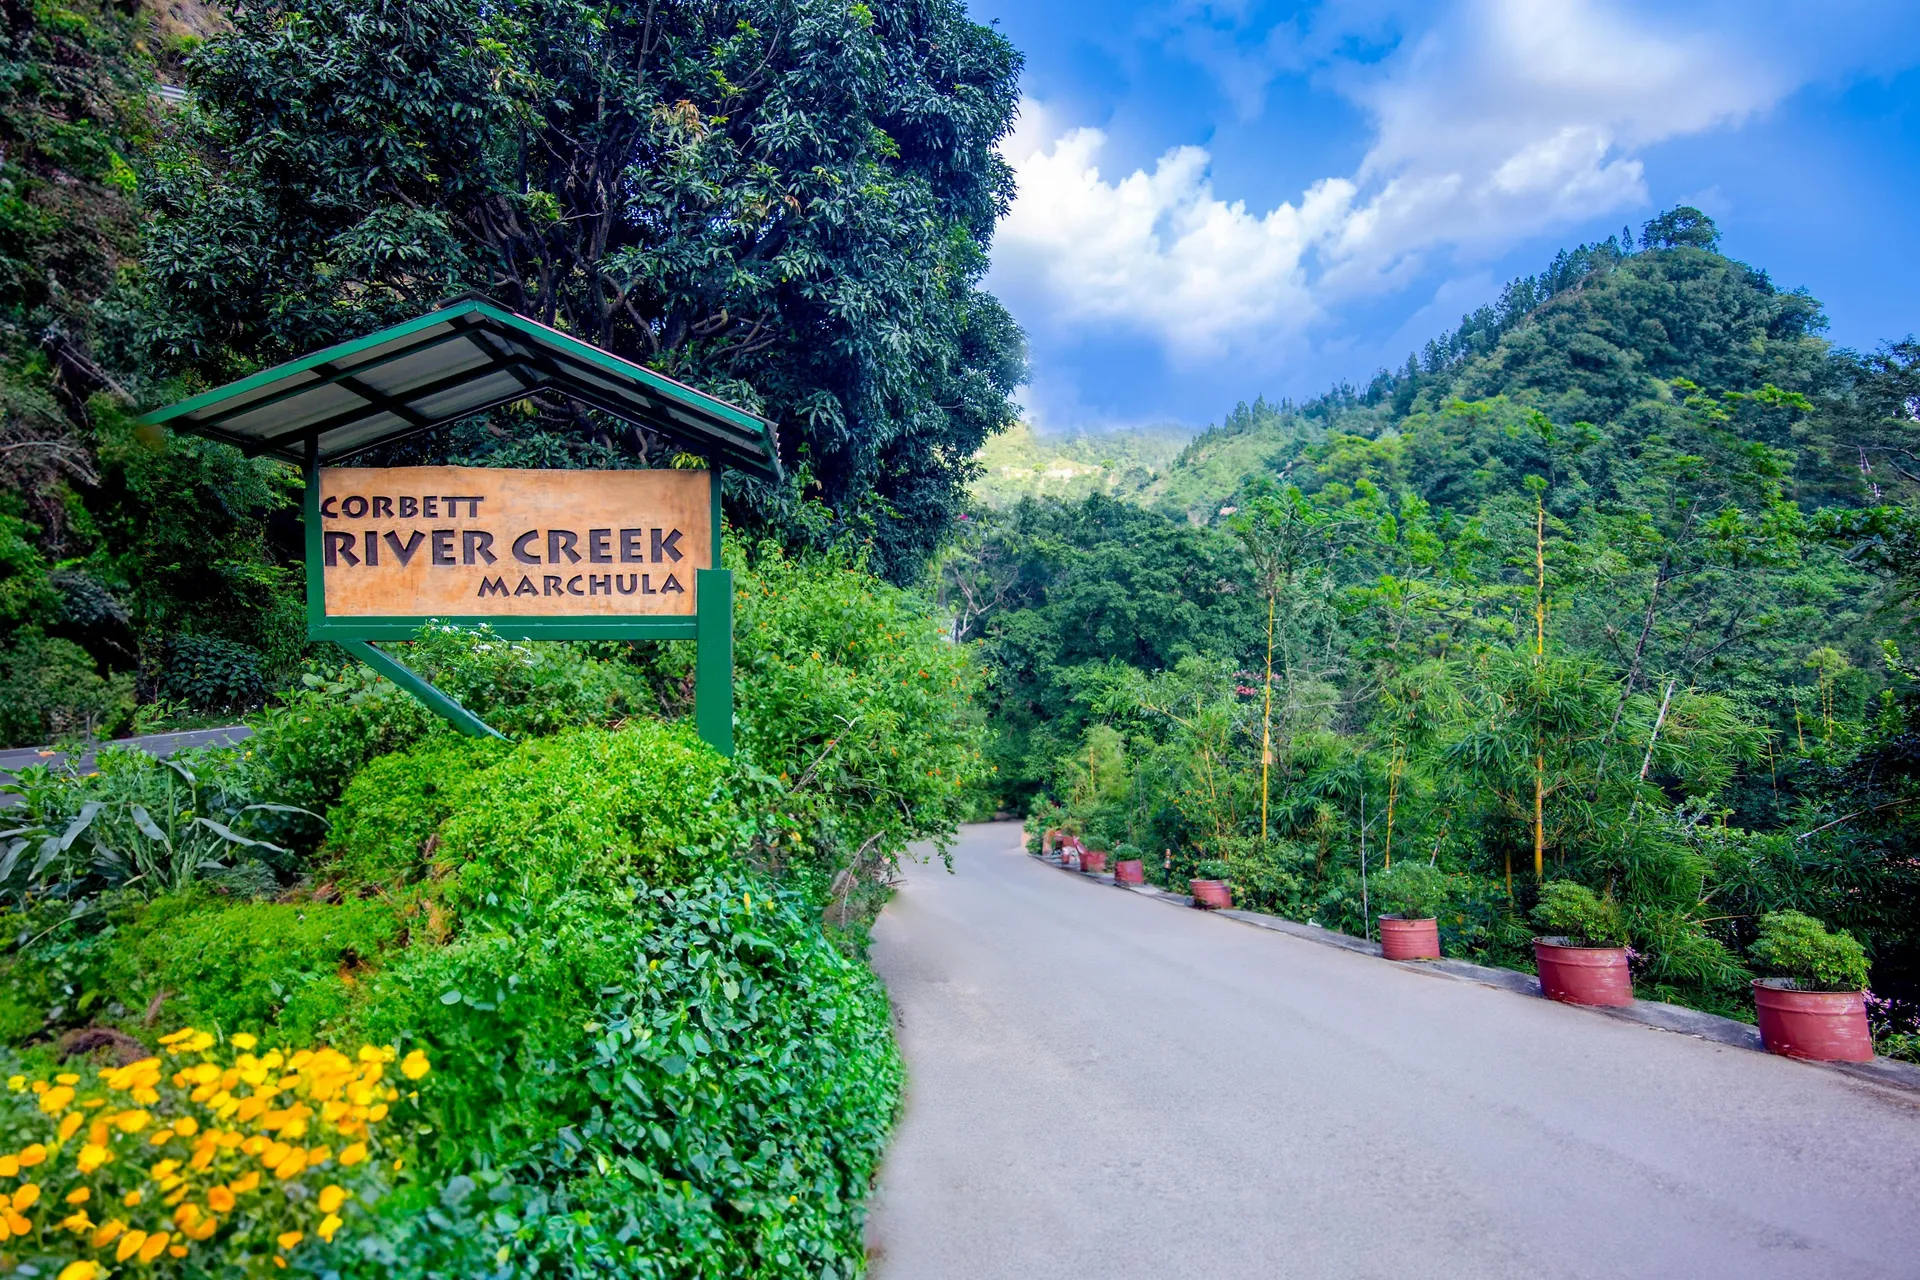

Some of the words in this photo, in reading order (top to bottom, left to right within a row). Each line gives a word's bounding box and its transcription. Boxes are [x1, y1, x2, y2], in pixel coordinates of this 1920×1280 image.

[321, 495, 486, 519] CORBETT
[323, 529, 498, 568] RIVER
[511, 528, 684, 565] CREEK
[477, 573, 685, 598] MARCHULA
